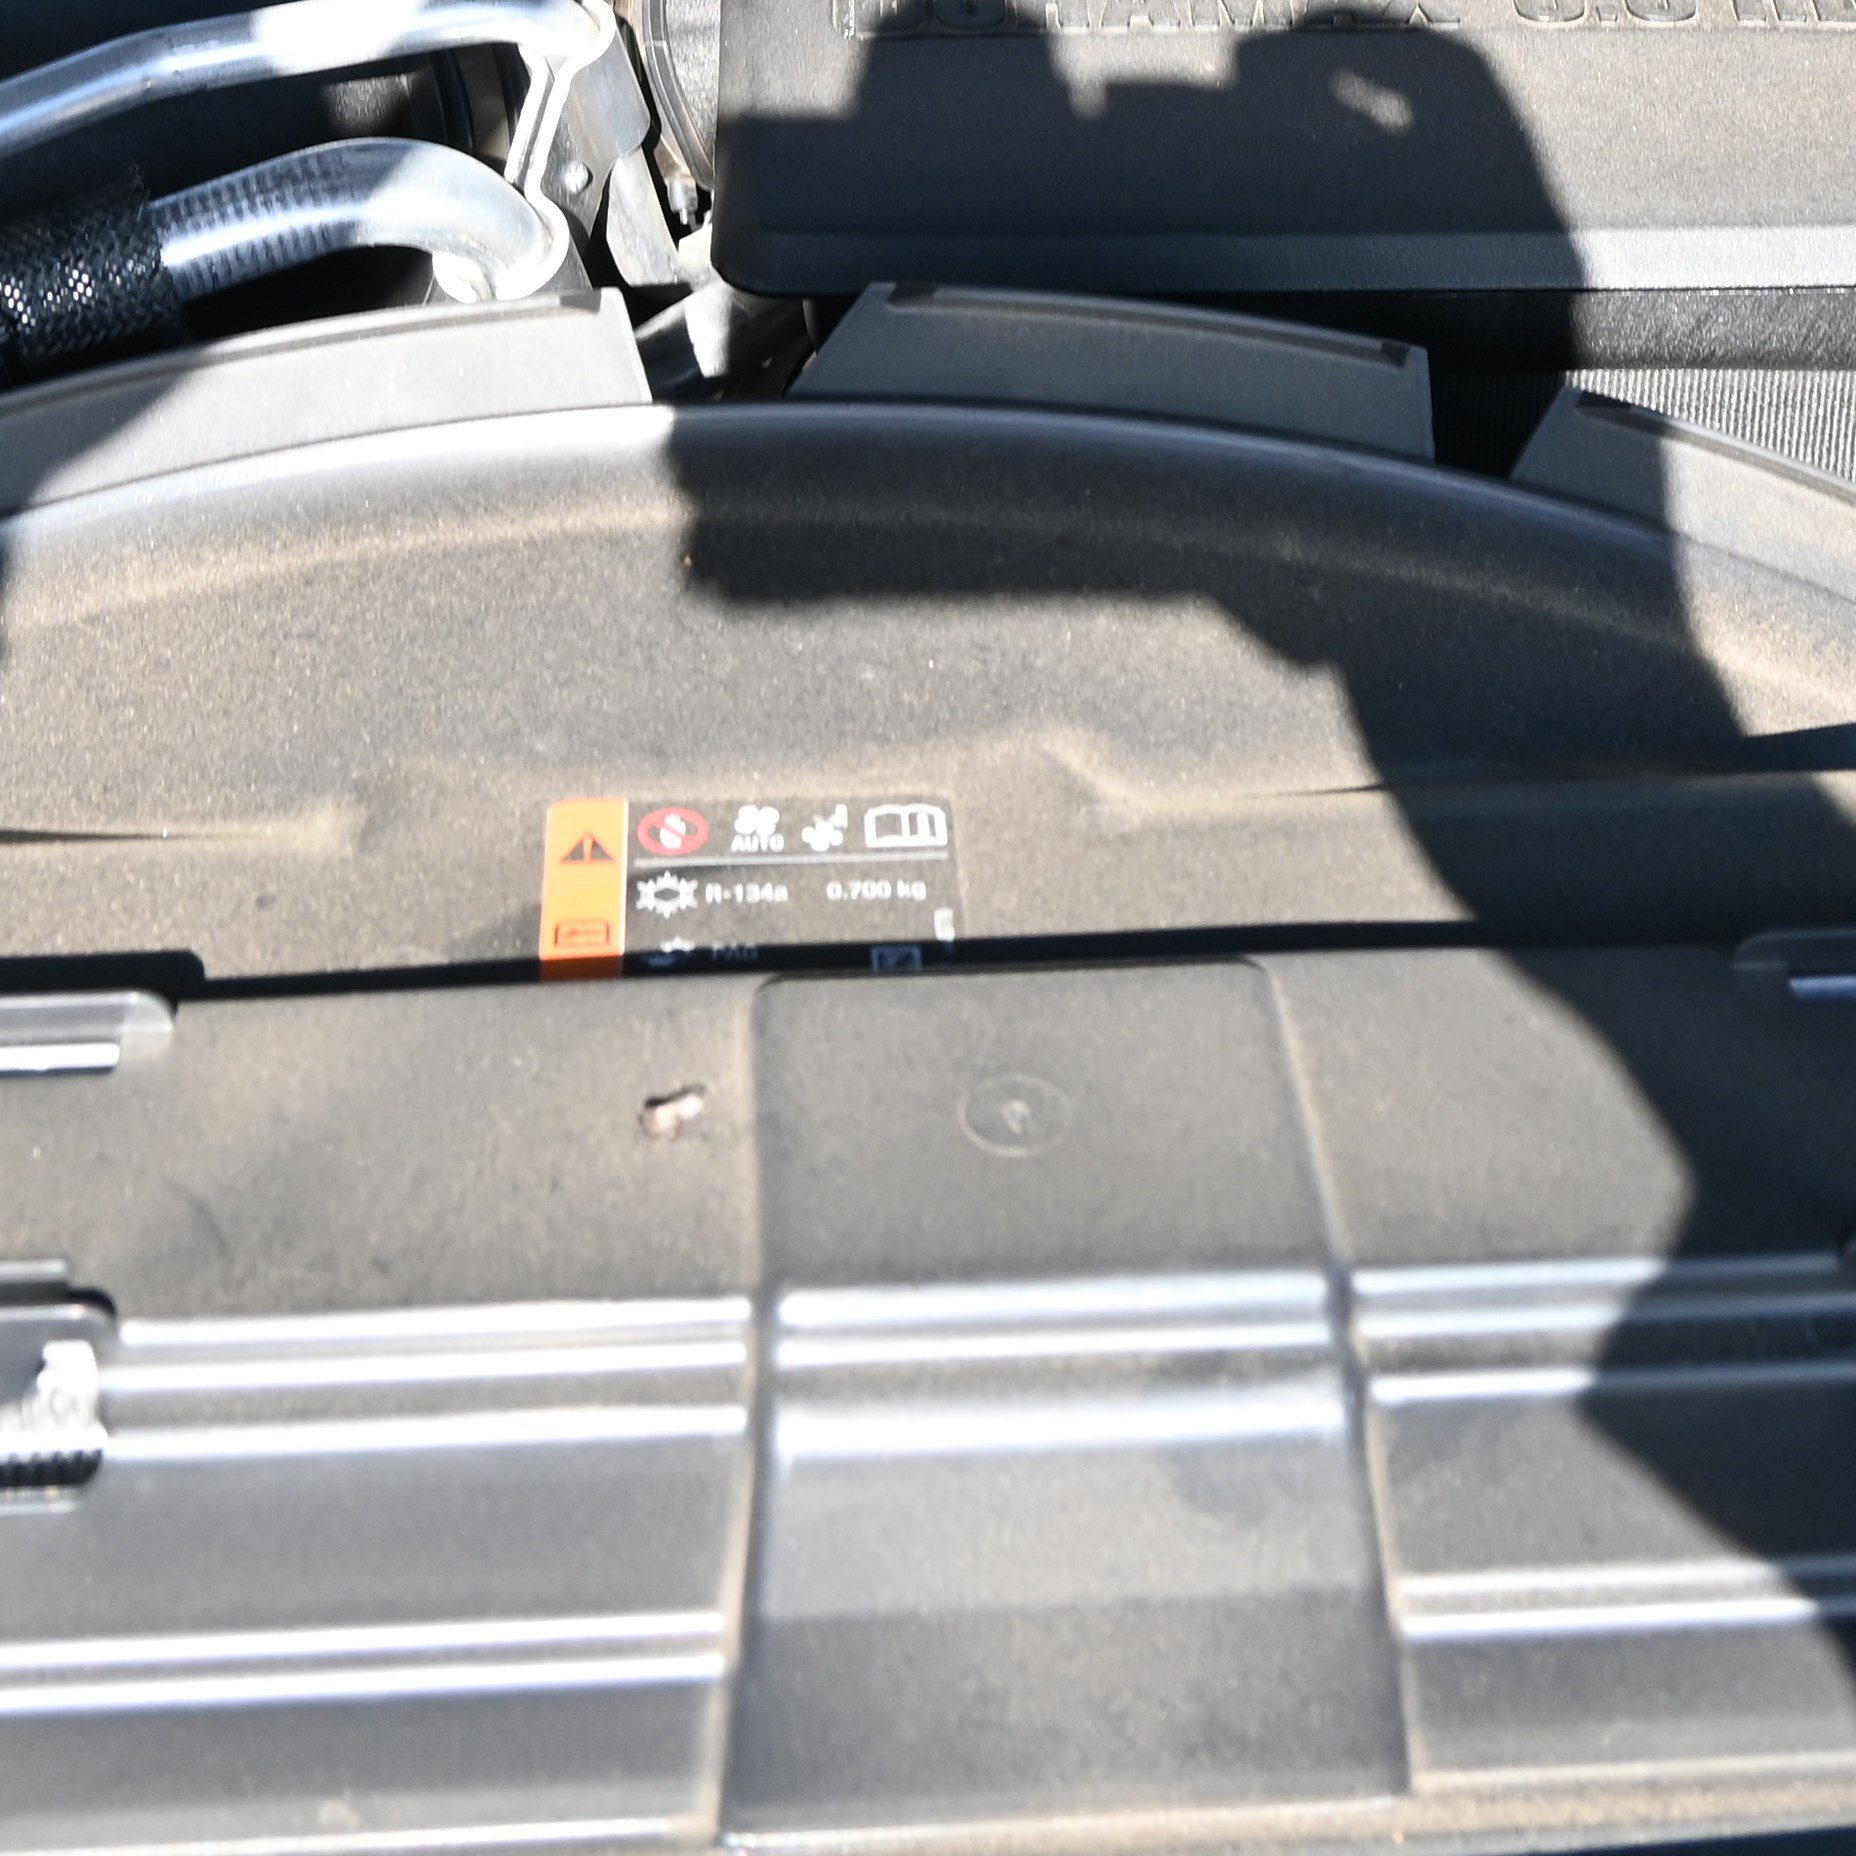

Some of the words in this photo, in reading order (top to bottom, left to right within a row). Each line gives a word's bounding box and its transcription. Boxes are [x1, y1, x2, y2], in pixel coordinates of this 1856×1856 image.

[730, 834, 785, 853] AUTO
[825, 878, 891, 901] 0.700
[896, 878, 927, 902] kg
